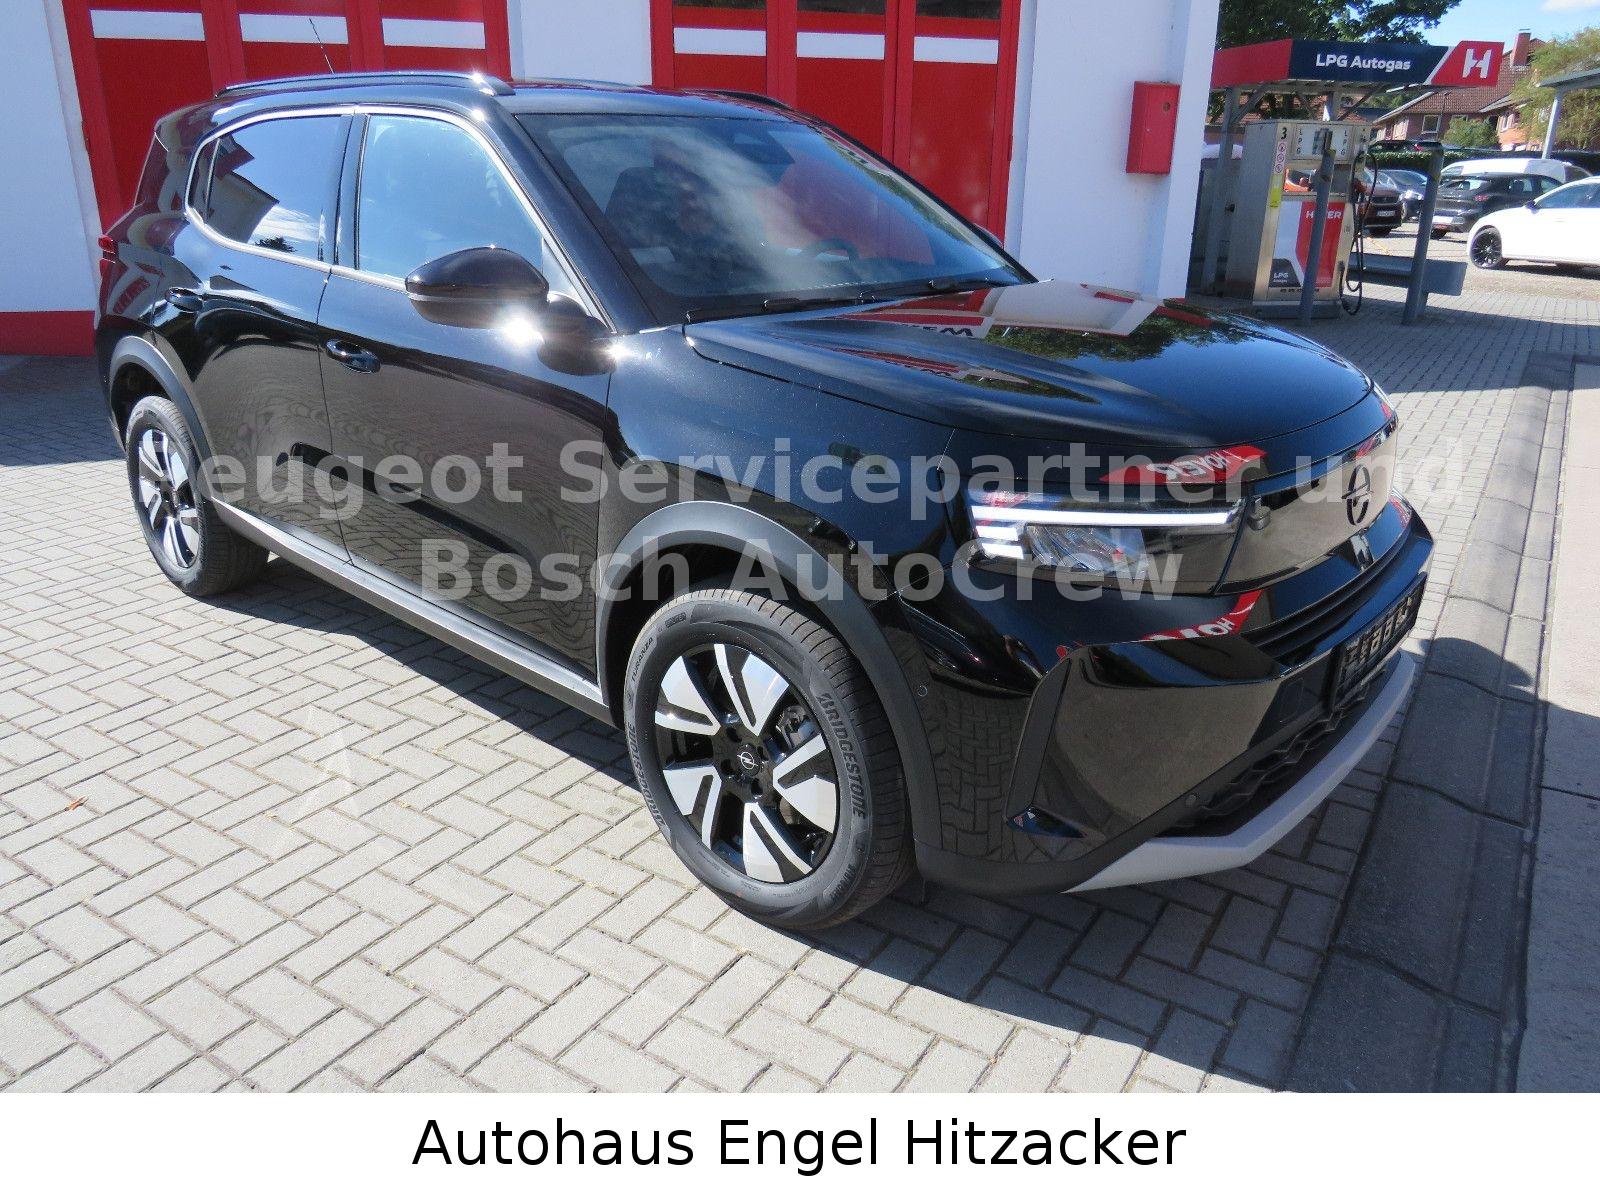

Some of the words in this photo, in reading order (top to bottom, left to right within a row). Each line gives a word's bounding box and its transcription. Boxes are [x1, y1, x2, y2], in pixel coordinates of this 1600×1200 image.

[1316, 53, 1348, 68] LPG
[1350, 55, 1411, 73] Autogas
[1462, 48, 1492, 79] H
[1280, 127, 1288, 140] 3
[1305, 210, 1342, 219] HER
[818, 691, 867, 820] BRIDGESTONE
